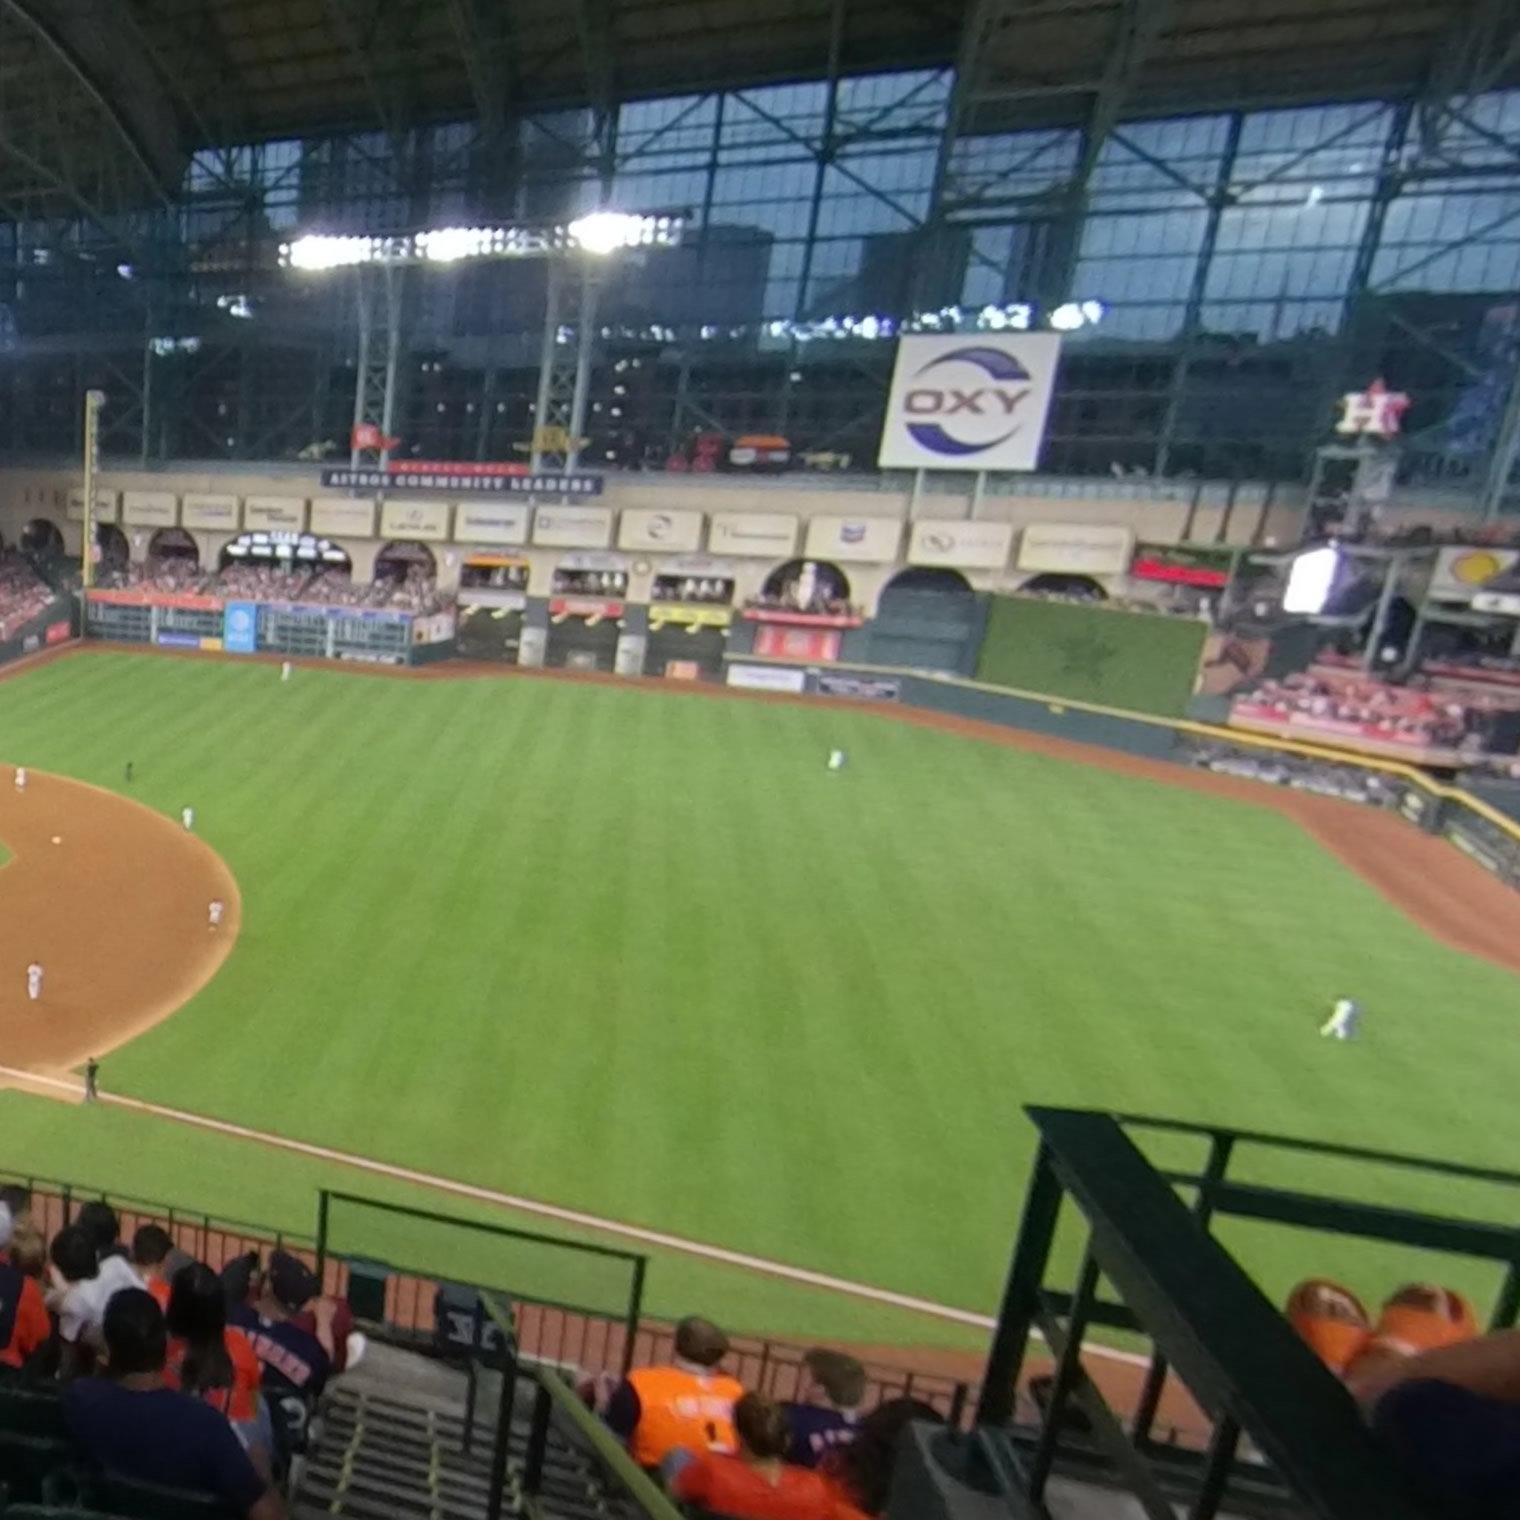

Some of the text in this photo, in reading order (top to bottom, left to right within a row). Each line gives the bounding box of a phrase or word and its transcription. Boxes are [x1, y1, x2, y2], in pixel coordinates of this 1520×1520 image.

[904, 388, 1031, 415] OXY
[330, 473, 594, 492] ASTROS COMMUNITY LEADERS
